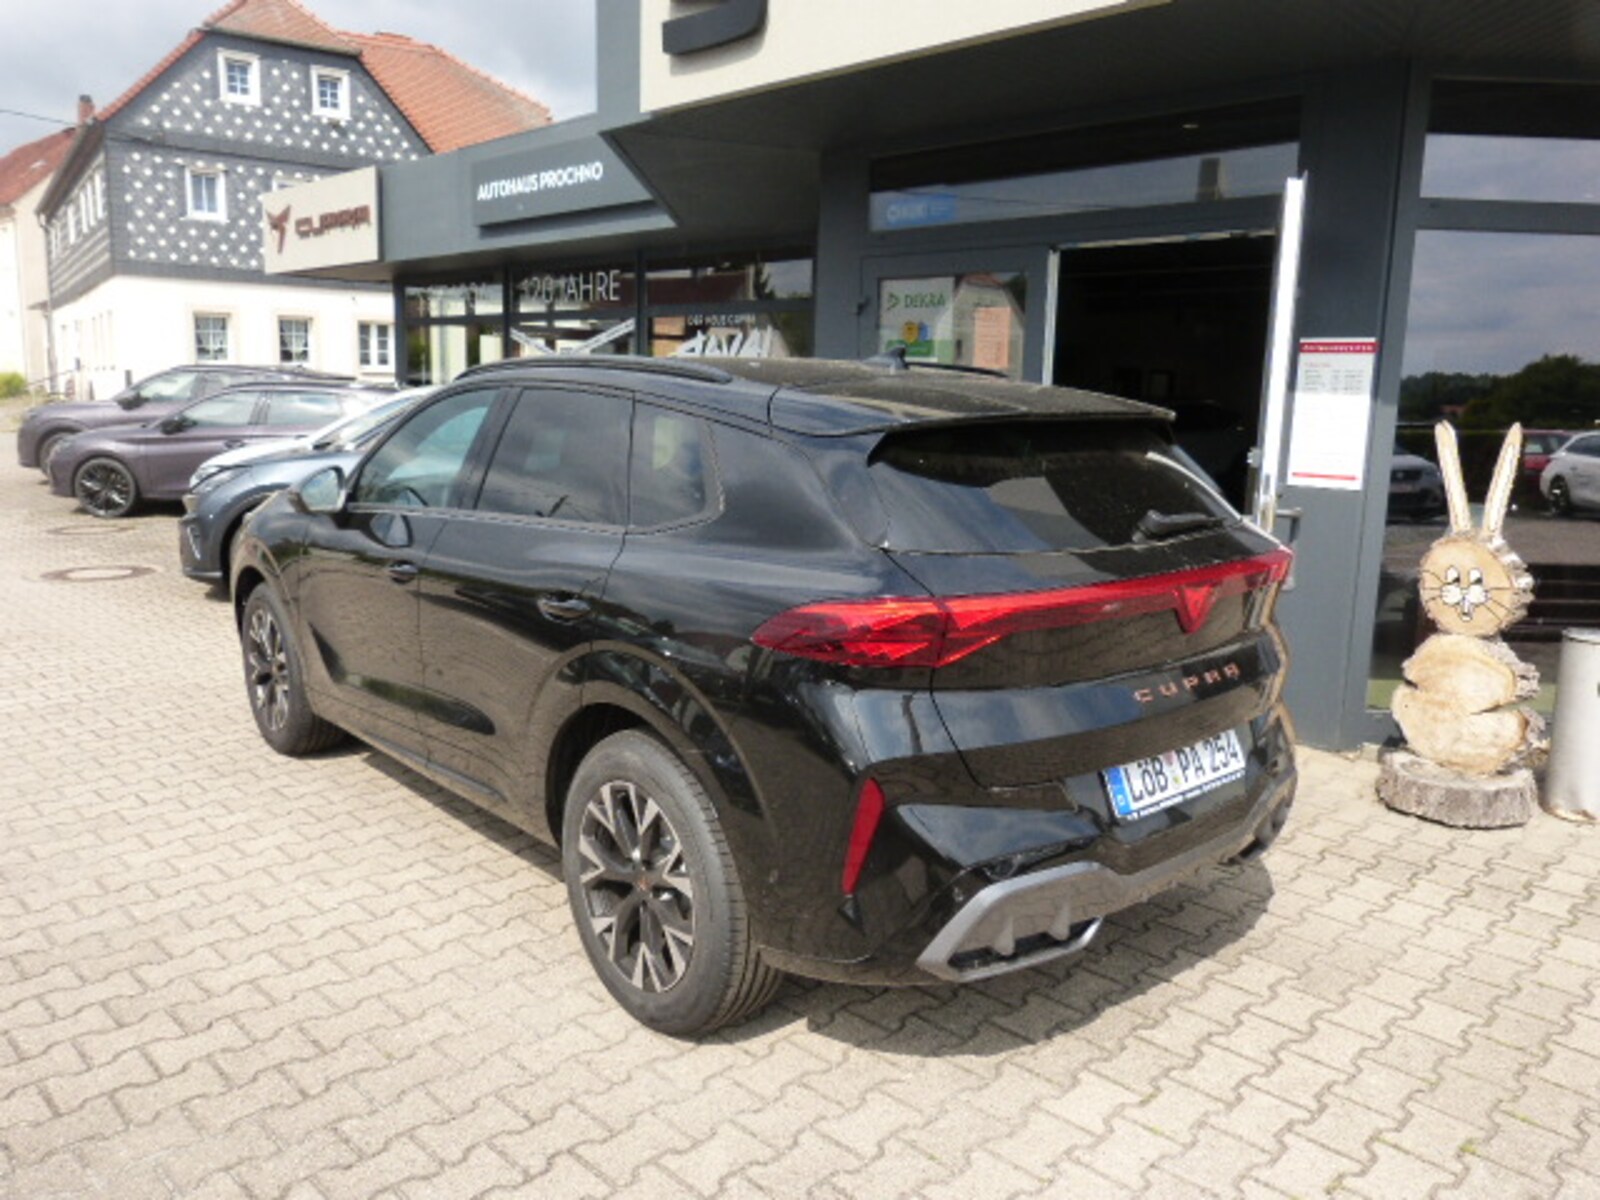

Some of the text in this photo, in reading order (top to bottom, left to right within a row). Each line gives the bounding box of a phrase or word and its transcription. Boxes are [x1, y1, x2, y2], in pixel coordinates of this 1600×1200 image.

[477, 160, 604, 201] AUTOHAUS PROCHNO
[904, 293, 947, 309] DEKRA
[1135, 663, 1240, 702] CUPRA
[1124, 757, 1168, 801] LÖB
[1174, 747, 1205, 783] PA
[1204, 733, 1241, 773] 254
